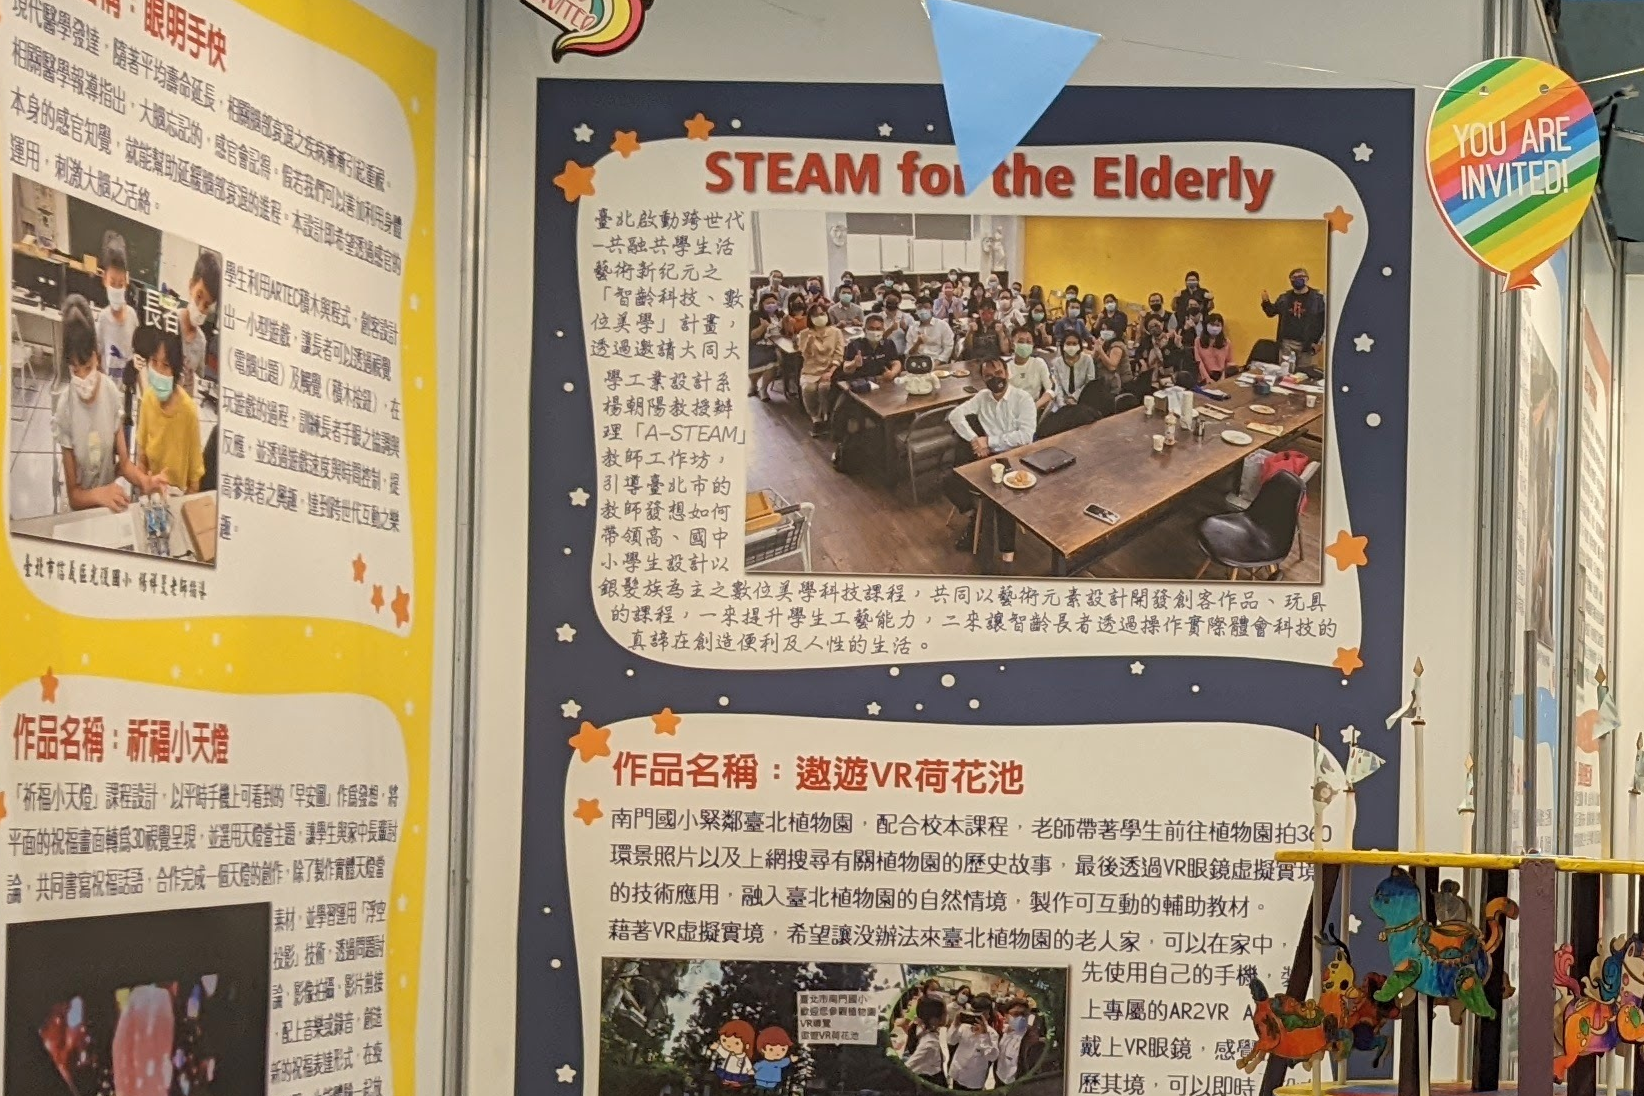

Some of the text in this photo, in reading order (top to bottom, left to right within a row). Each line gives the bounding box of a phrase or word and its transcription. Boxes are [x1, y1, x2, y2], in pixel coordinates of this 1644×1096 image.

[1453, 116, 1572, 158] YOU ARE
[706, 150, 880, 195] STEAM
[993, 153, 1075, 198] the
[1094, 154, 1275, 212] Elderly
[1461, 159, 1570, 200] INVITED!
[612, 751, 1025, 796] 作品名稱：遨遊VR荷花池
